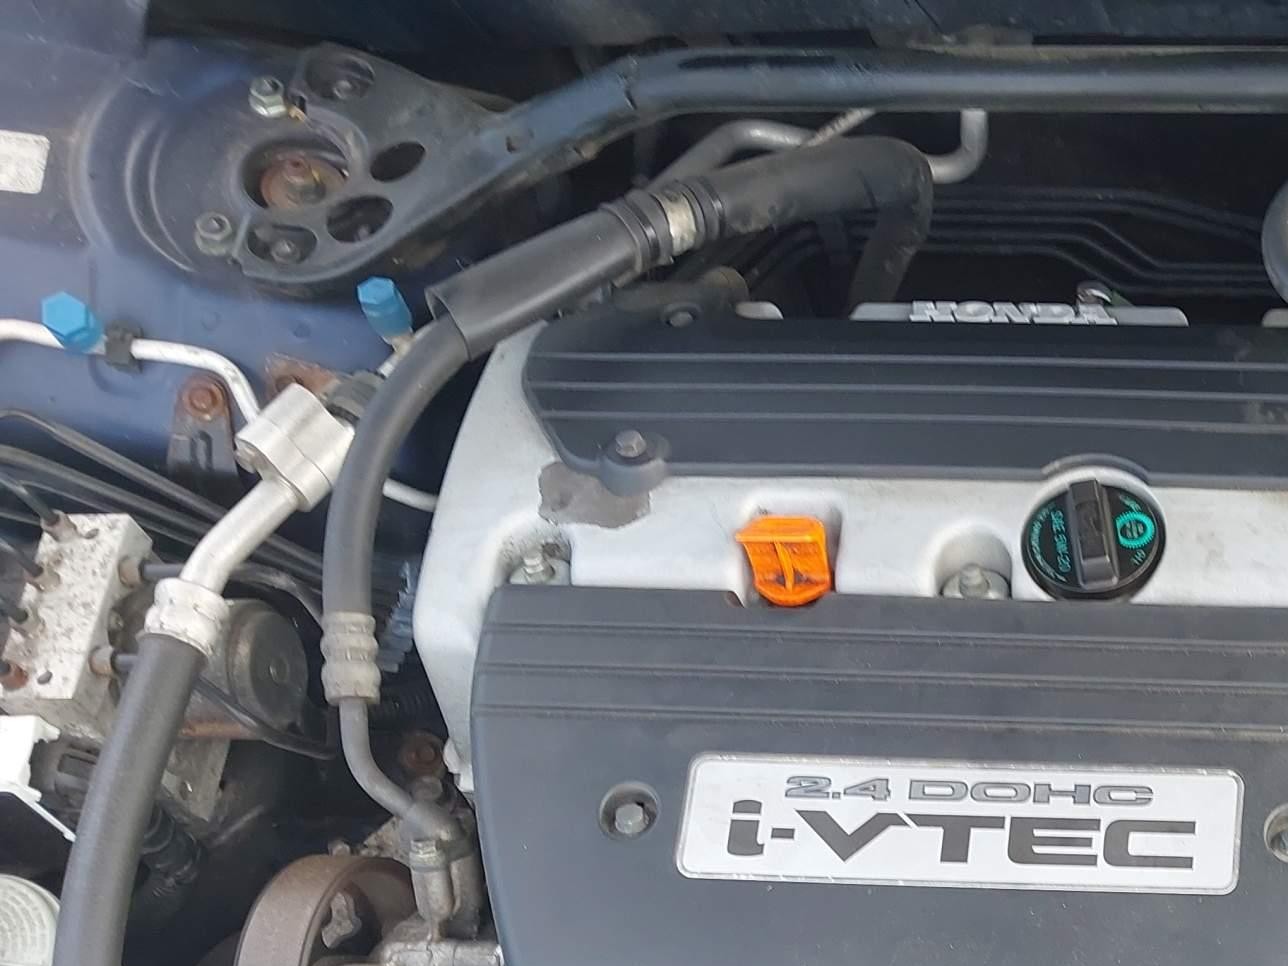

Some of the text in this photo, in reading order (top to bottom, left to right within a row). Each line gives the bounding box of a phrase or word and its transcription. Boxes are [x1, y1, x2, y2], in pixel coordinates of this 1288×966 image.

[910, 300, 1118, 325] HONDA
[785, 775, 1154, 806] 2.4 DOHC
[727, 799, 1197, 870] i-VTEC
